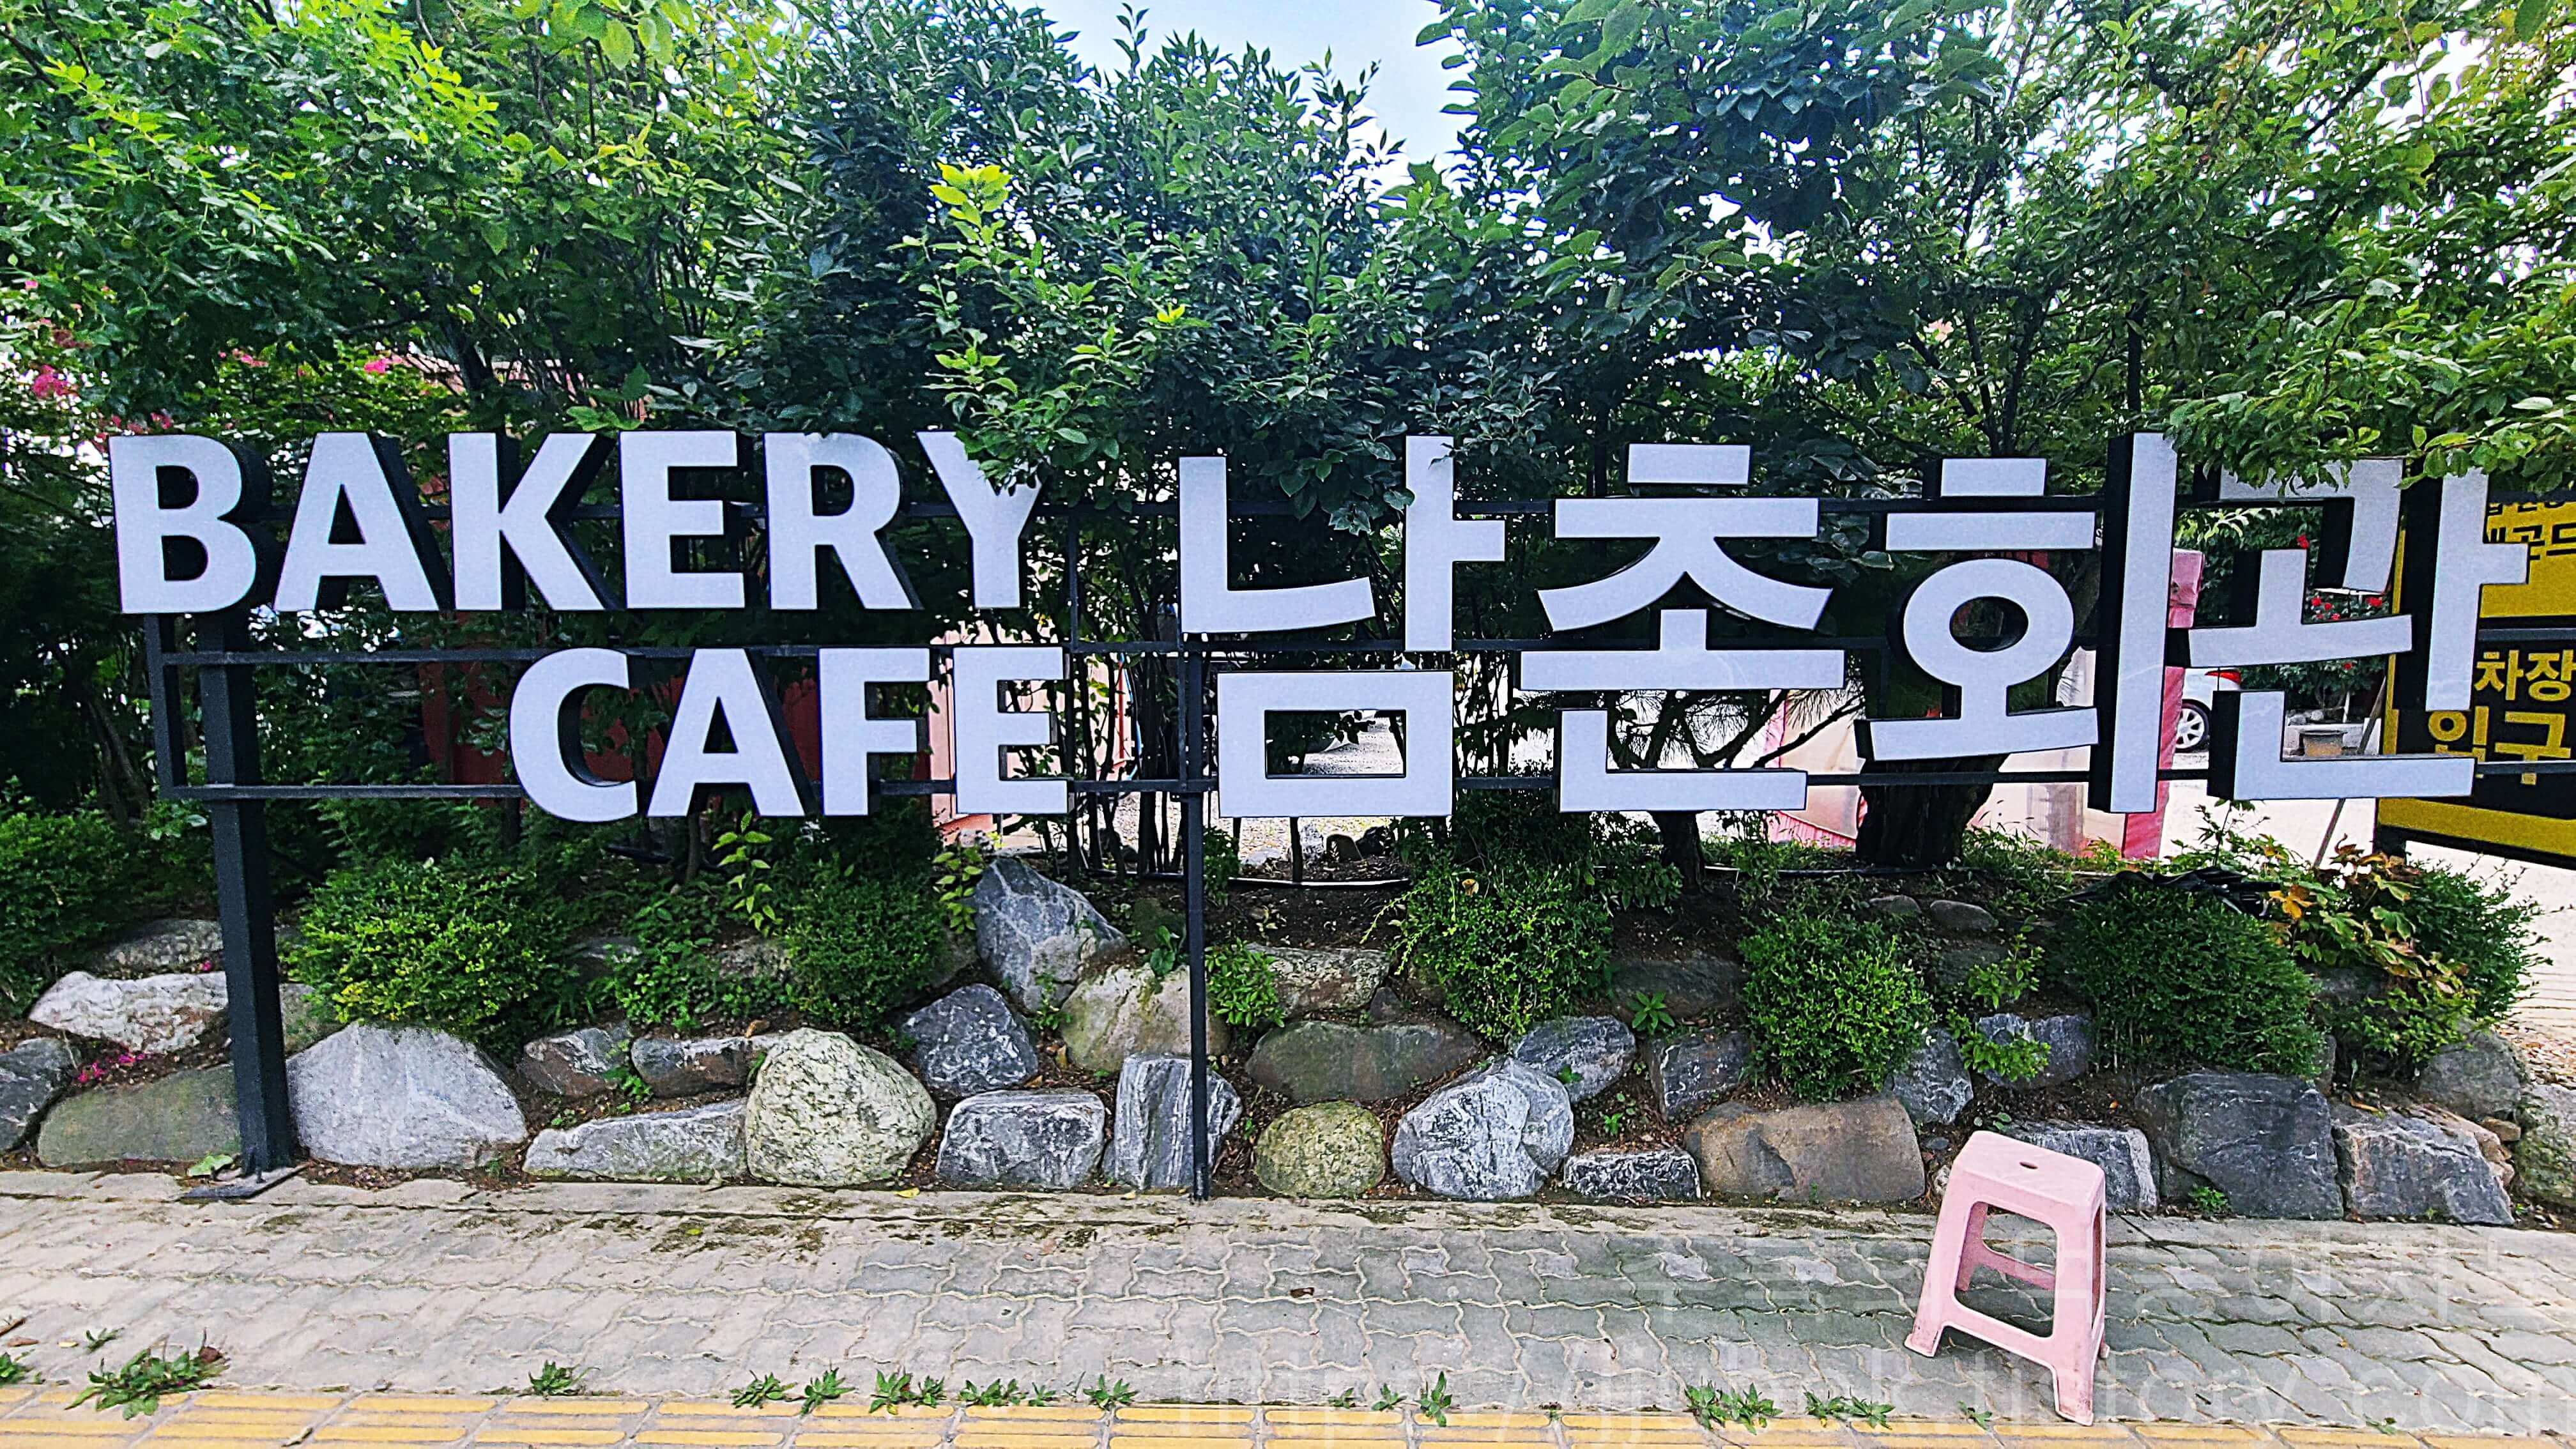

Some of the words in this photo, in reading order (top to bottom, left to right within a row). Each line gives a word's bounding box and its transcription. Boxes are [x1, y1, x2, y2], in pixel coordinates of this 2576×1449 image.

[109, 429, 1044, 615] BAKERY
[1178, 433, 2528, 817] 남촌회관
[509, 645, 1070, 822] CAFE
[2428, 705, 2572, 785] 입구
